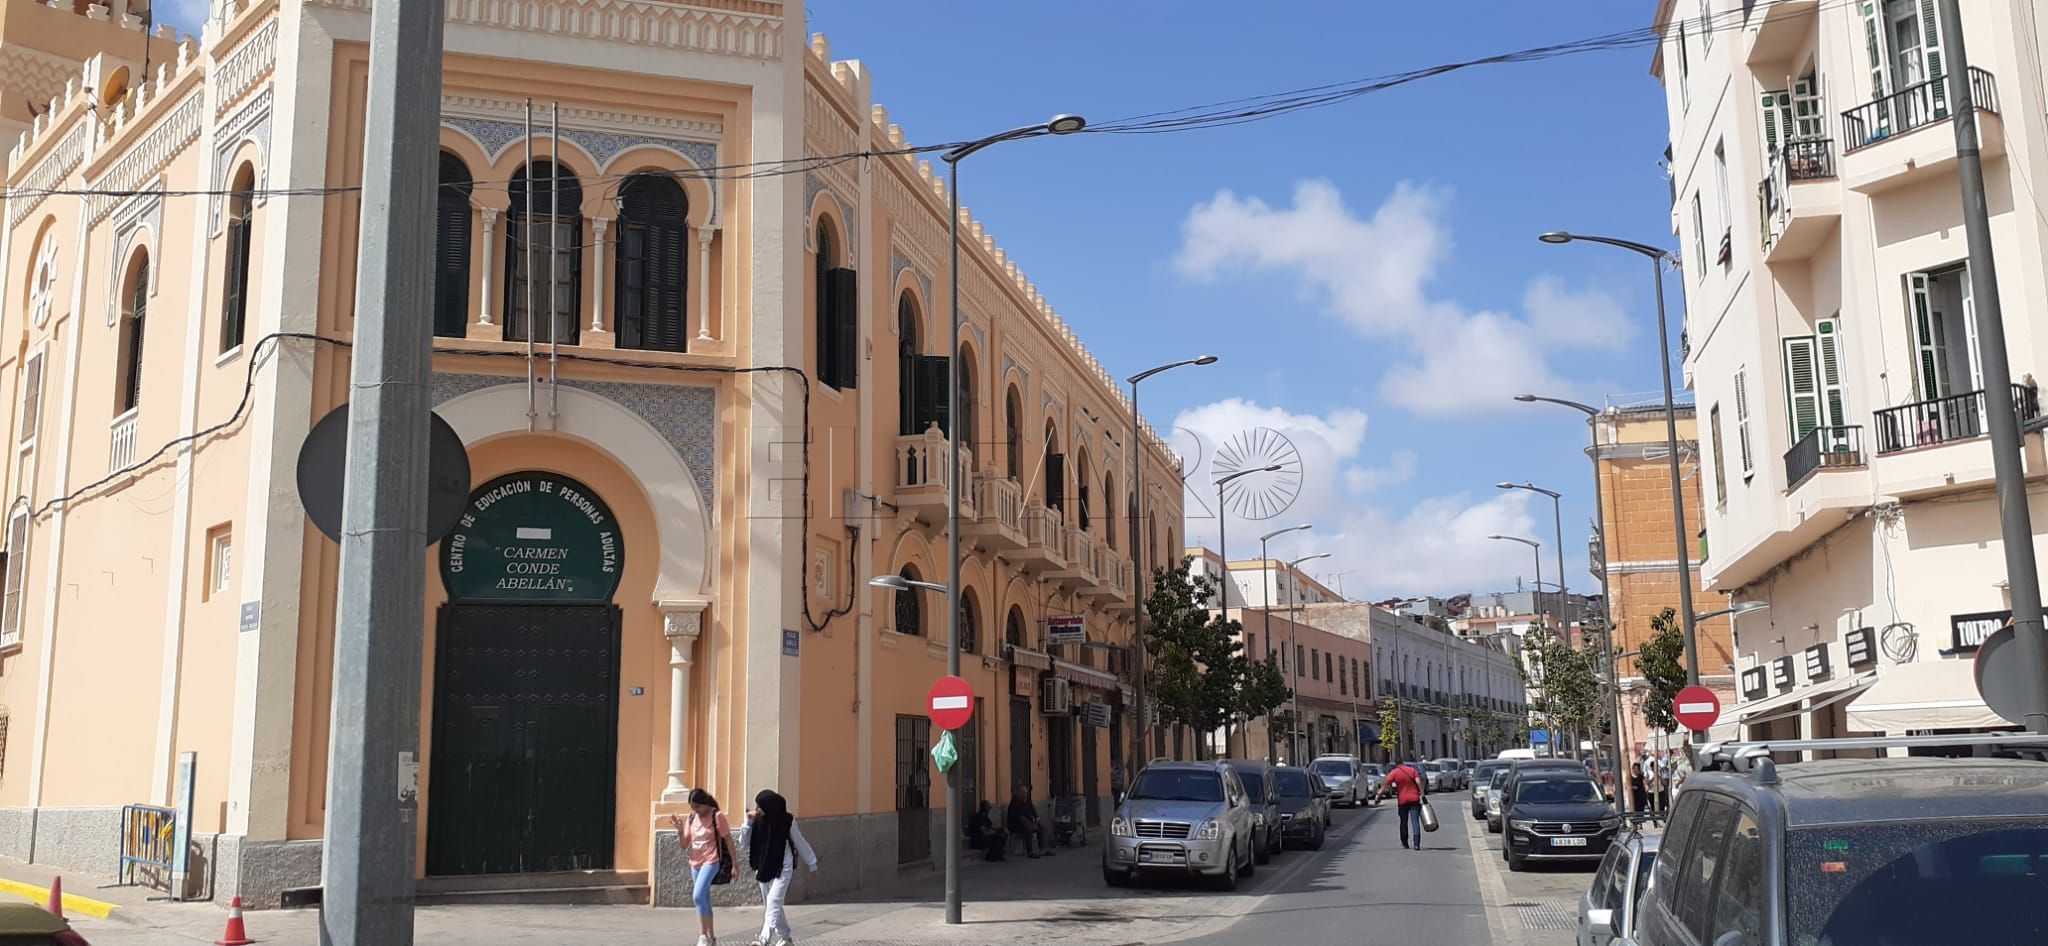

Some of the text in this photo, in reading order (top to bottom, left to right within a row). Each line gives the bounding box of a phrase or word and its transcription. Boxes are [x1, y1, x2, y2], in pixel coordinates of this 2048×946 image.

[451, 480, 617, 573] CENTRO DE EDUCACIÓN DE PERSONAS ADULTAS
[503, 547, 568, 559] CARMEN
[506, 563, 560, 575] CONDE
